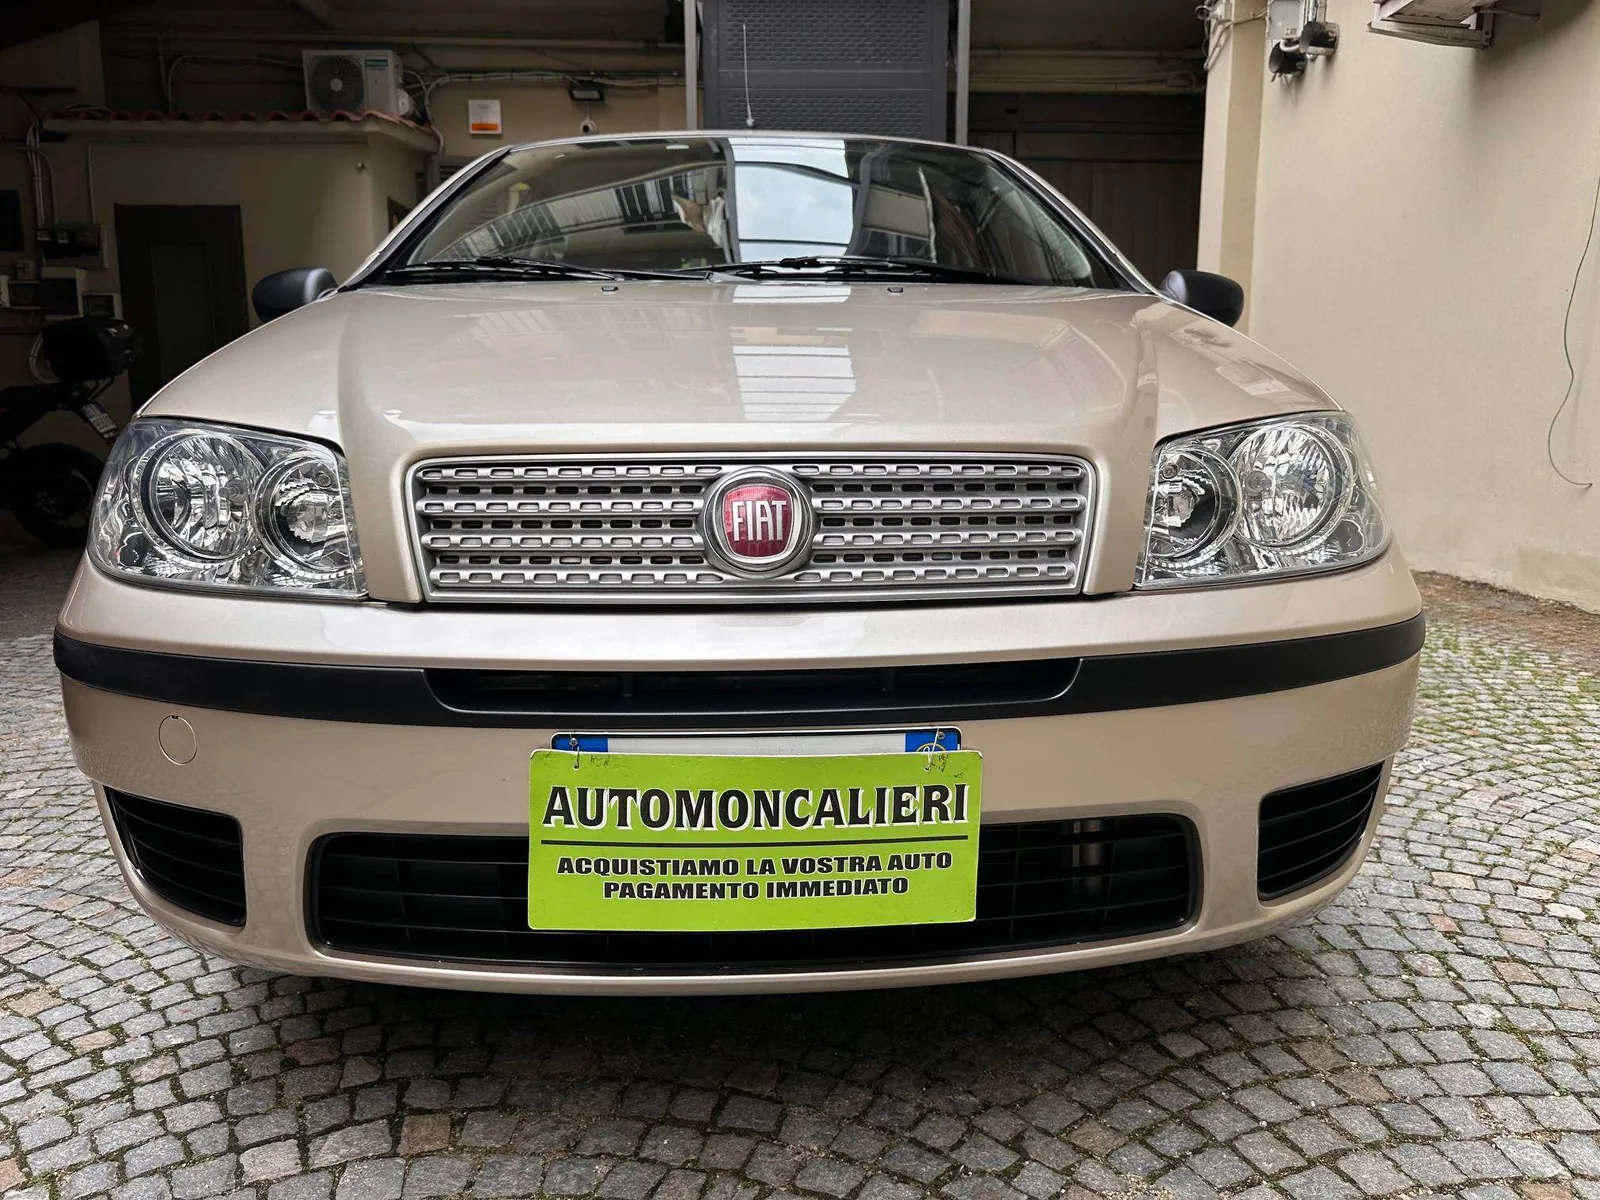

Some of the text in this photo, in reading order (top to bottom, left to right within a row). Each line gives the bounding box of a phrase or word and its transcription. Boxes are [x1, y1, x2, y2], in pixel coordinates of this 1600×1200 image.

[732, 500, 787, 541] FIAT
[541, 783, 969, 831] AUTOMONCALIERI
[557, 852, 952, 876] ACQUISTIAMO LA VOSTRA AUTO
[603, 877, 909, 899] PAGAMENTO IMMEDIATO
